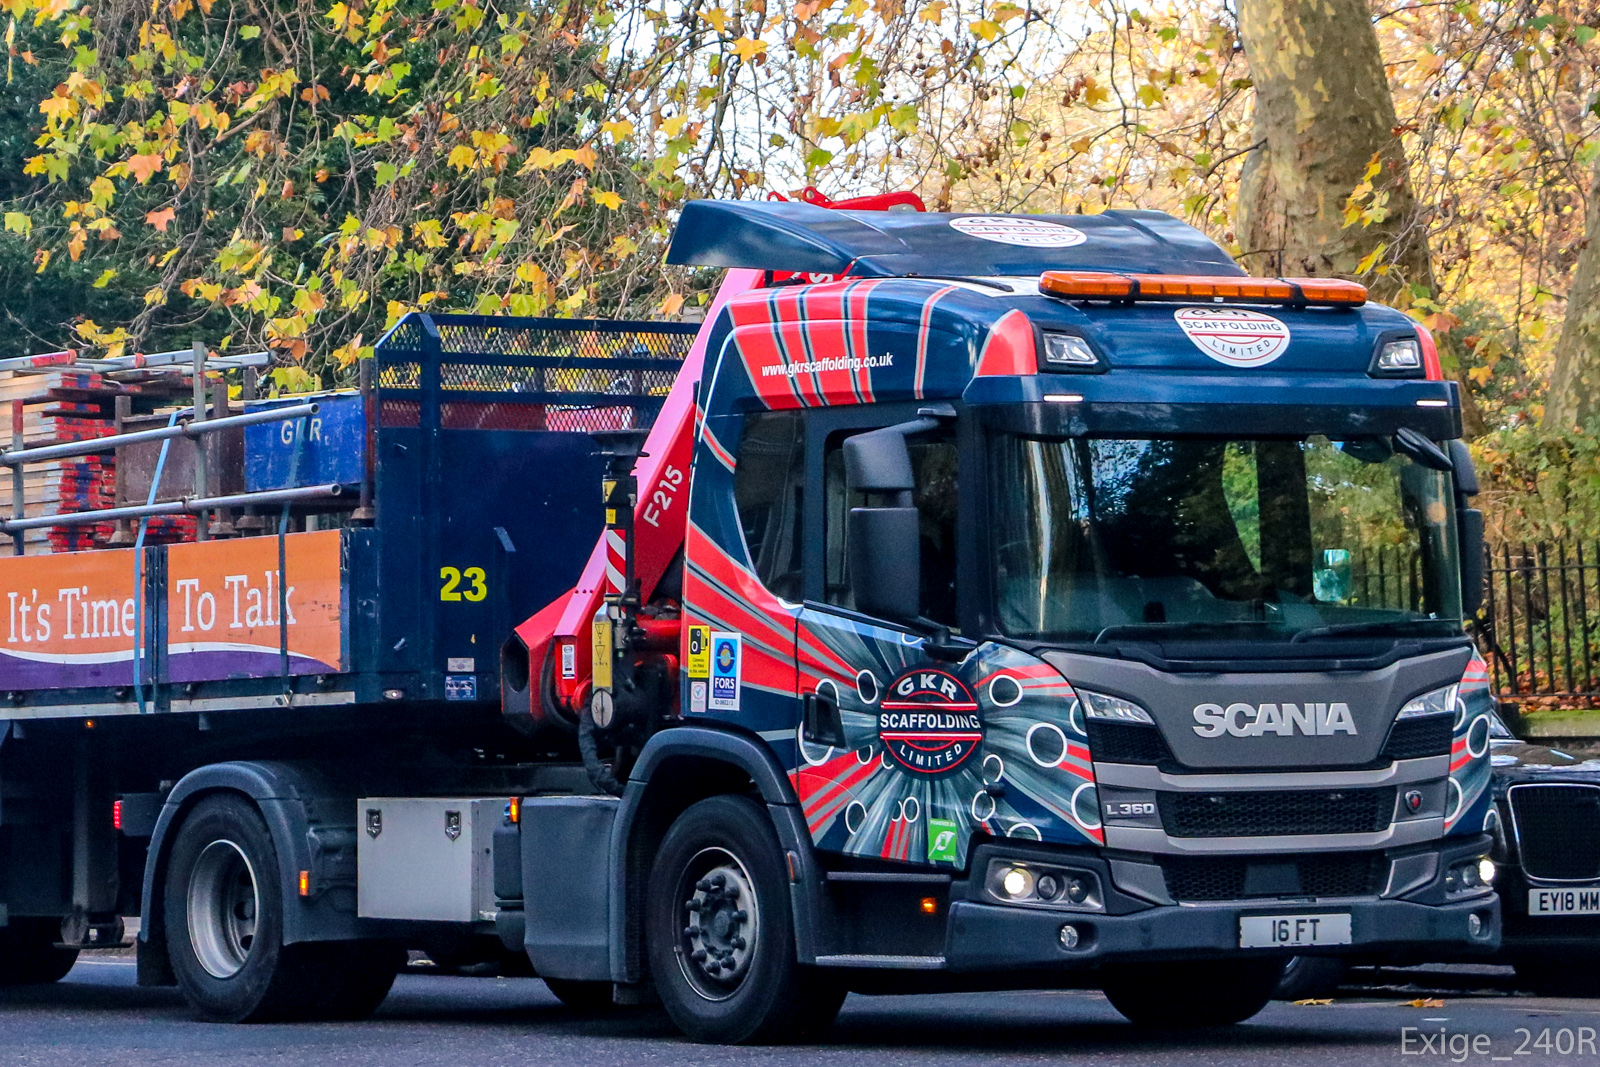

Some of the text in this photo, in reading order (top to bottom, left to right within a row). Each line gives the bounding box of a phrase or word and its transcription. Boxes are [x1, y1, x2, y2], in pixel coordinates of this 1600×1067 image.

[960, 225, 1075, 234] SCAFFOLDING
[1183, 320, 1282, 331] SCAFFOLDING
[1212, 339, 1271, 356] LIMITED
[761, 352, 893, 378] www.gkrscaffolding.co.uk
[643, 464, 683, 528] F215
[440, 566, 488, 602] 23
[7, 569, 297, 643] It's Time To Talk
[714, 677, 735, 690] FORS
[897, 673, 957, 701] GKR
[880, 713, 981, 729] SCAFFOLDING
[1192, 702, 1358, 738] SCANIA
[900, 743, 962, 767] LIMITED
[1539, 892, 1575, 911] EY18
[1272, 918, 1320, 942] 16 FT
